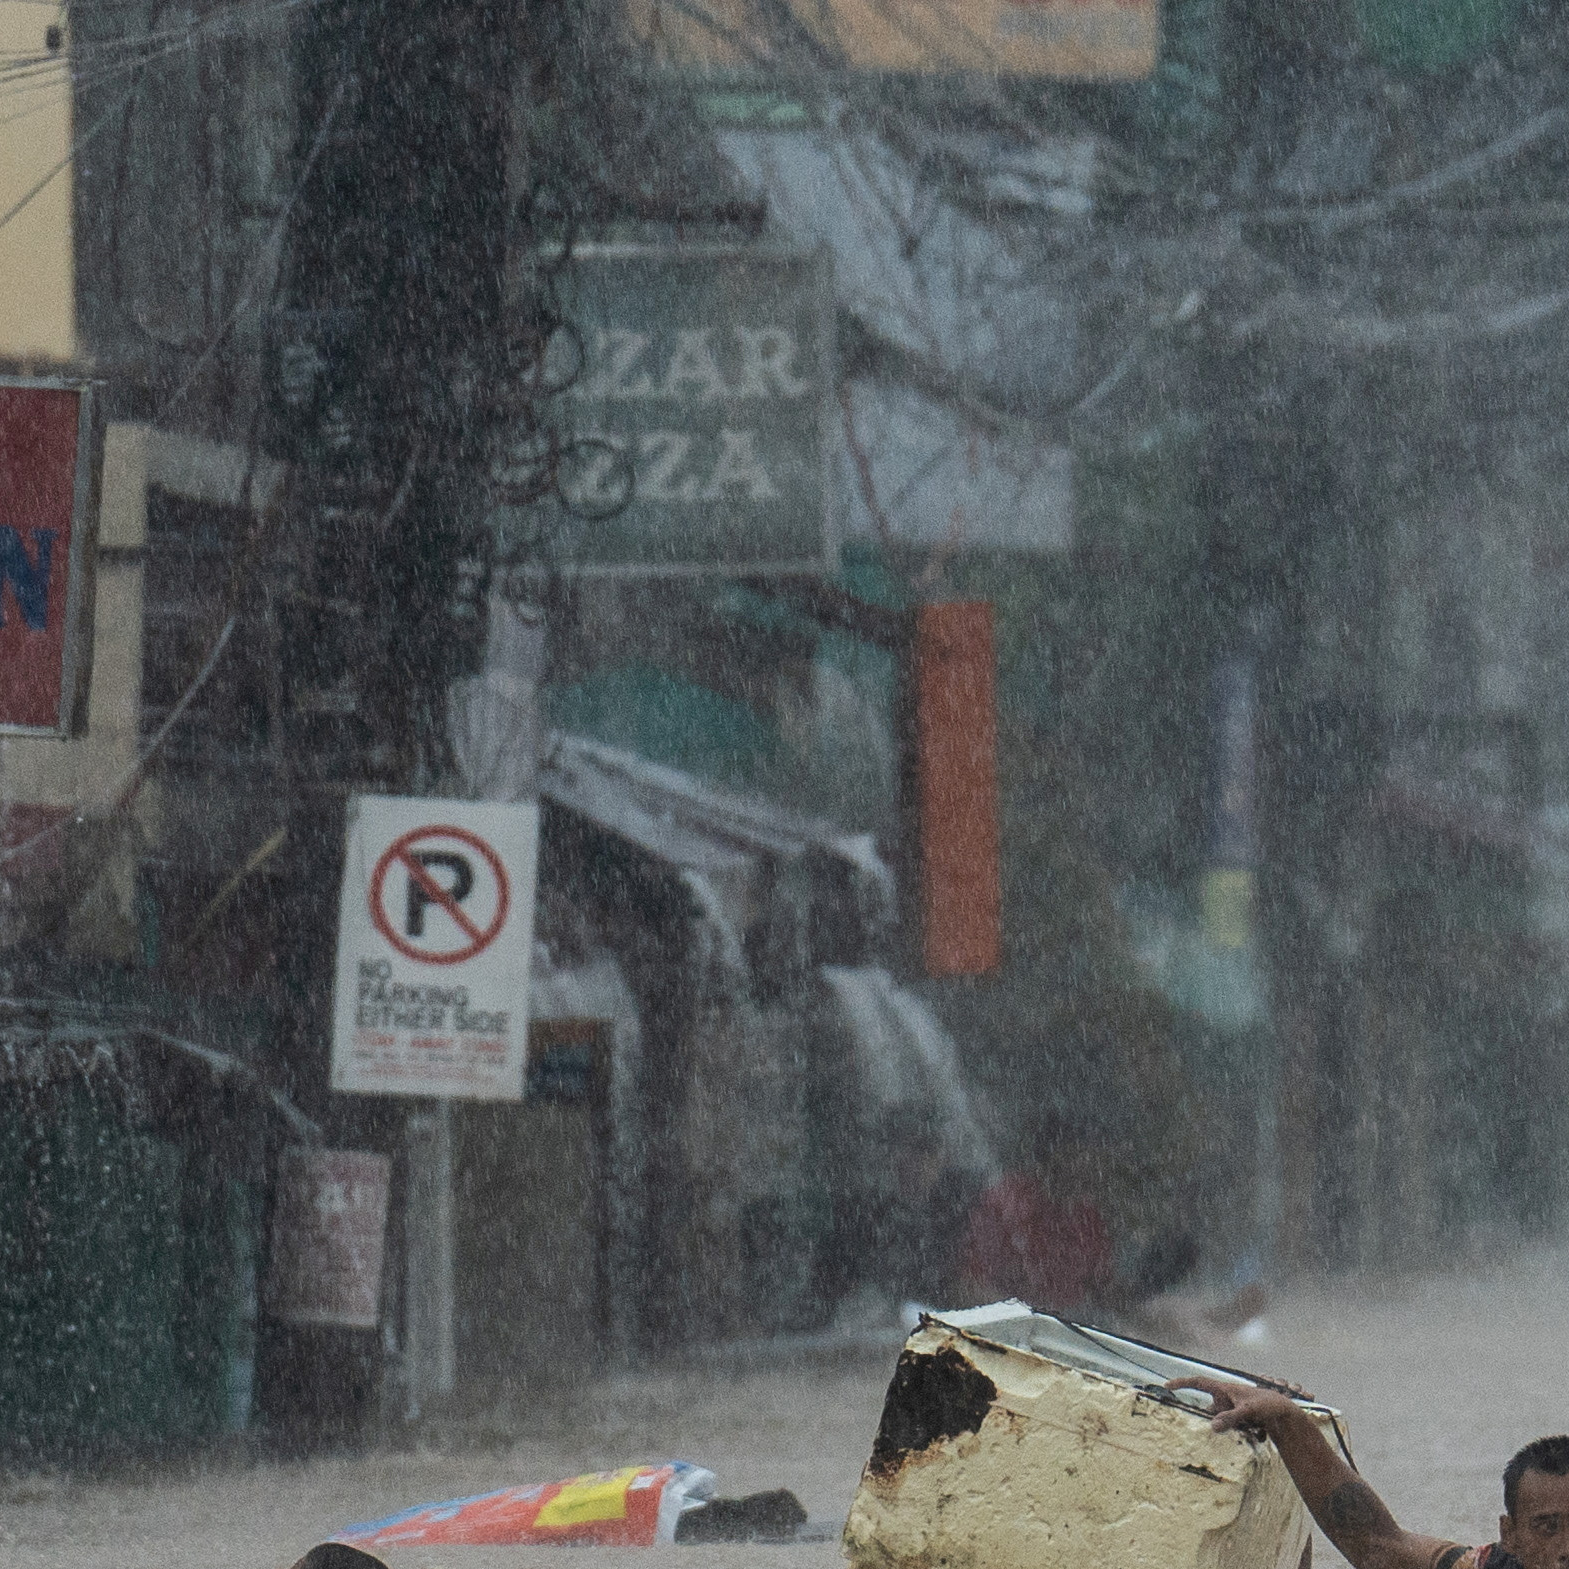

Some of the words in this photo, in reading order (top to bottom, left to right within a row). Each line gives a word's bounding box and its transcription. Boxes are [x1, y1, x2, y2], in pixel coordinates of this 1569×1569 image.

[583, 327, 809, 401] ZAR
[358, 959, 393, 980] NO
[357, 977, 469, 1006] PARKING
[355, 1003, 445, 1029] EITHER
